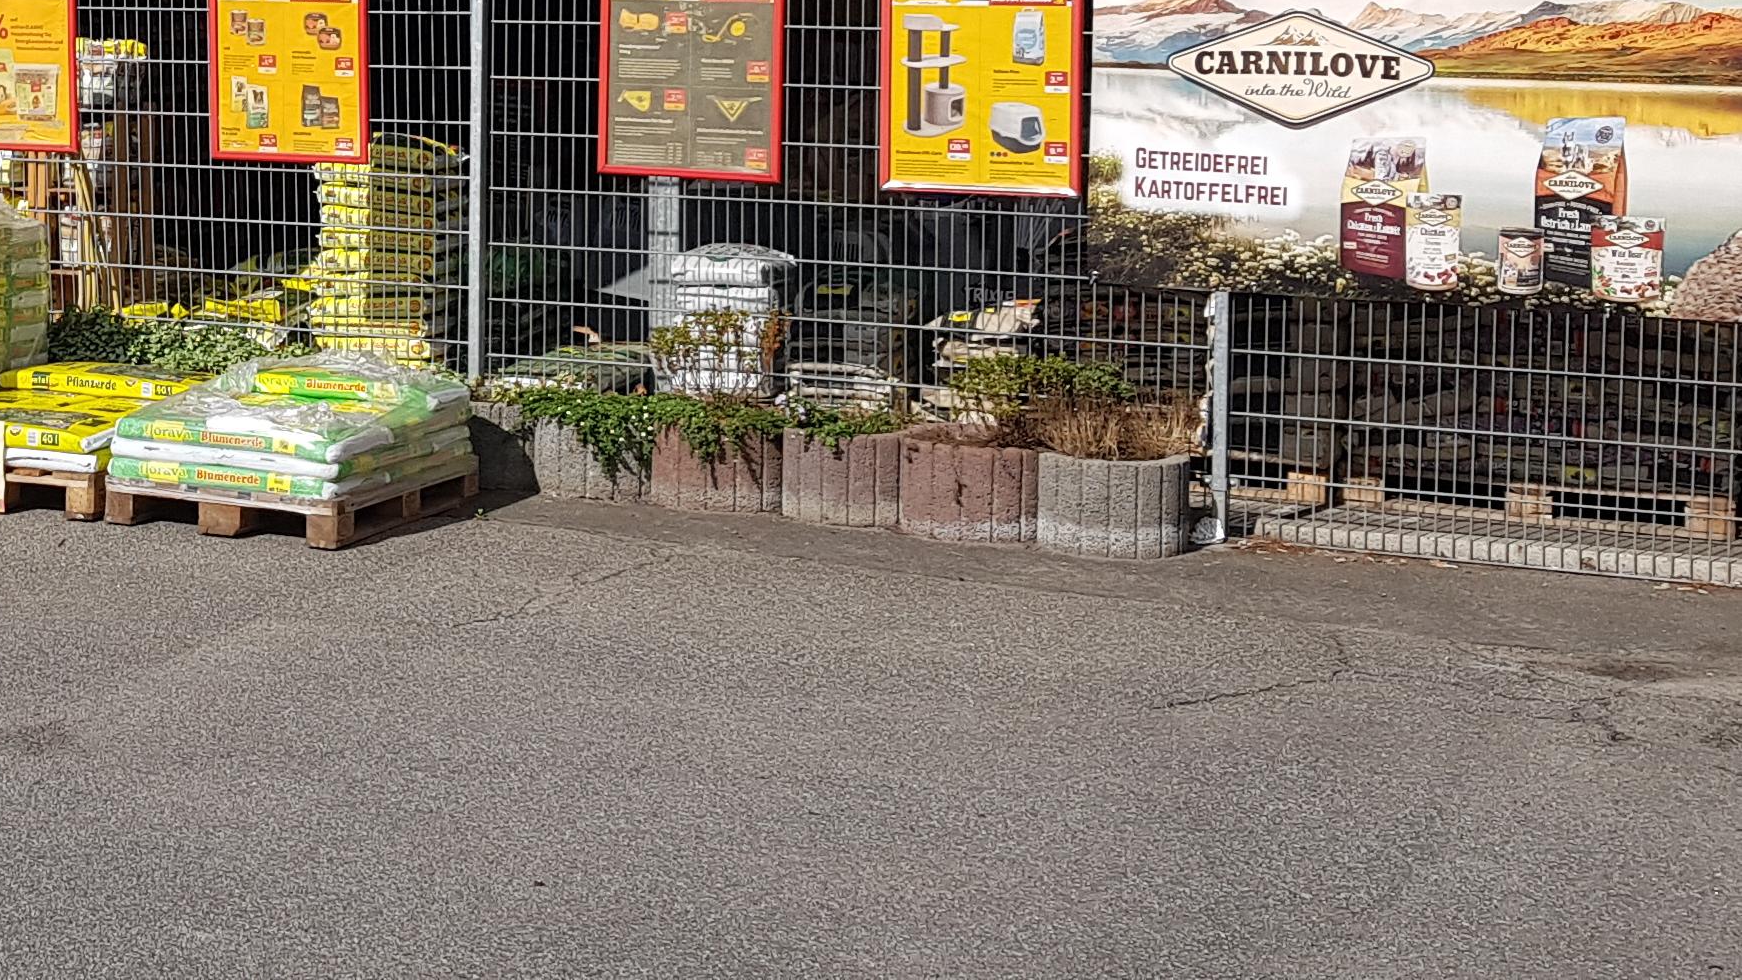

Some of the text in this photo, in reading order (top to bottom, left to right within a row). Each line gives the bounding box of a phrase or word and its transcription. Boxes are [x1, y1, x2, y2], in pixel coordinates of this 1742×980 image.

[1194, 50, 1401, 81] CARNILOVE
[1244, 78, 1352, 99] into the Wild
[1135, 147, 1268, 176] GETREIDEFREI
[1134, 176, 1288, 206] KARTOFFELFREI
[1548, 179, 1596, 190] CARNILOVE
[66, 375, 117, 391] Pflanzerde
[305, 378, 367, 393] Blumenerde
[200, 430, 265, 448] Blumenerde
[196, 468, 260, 486] Blumenerde
